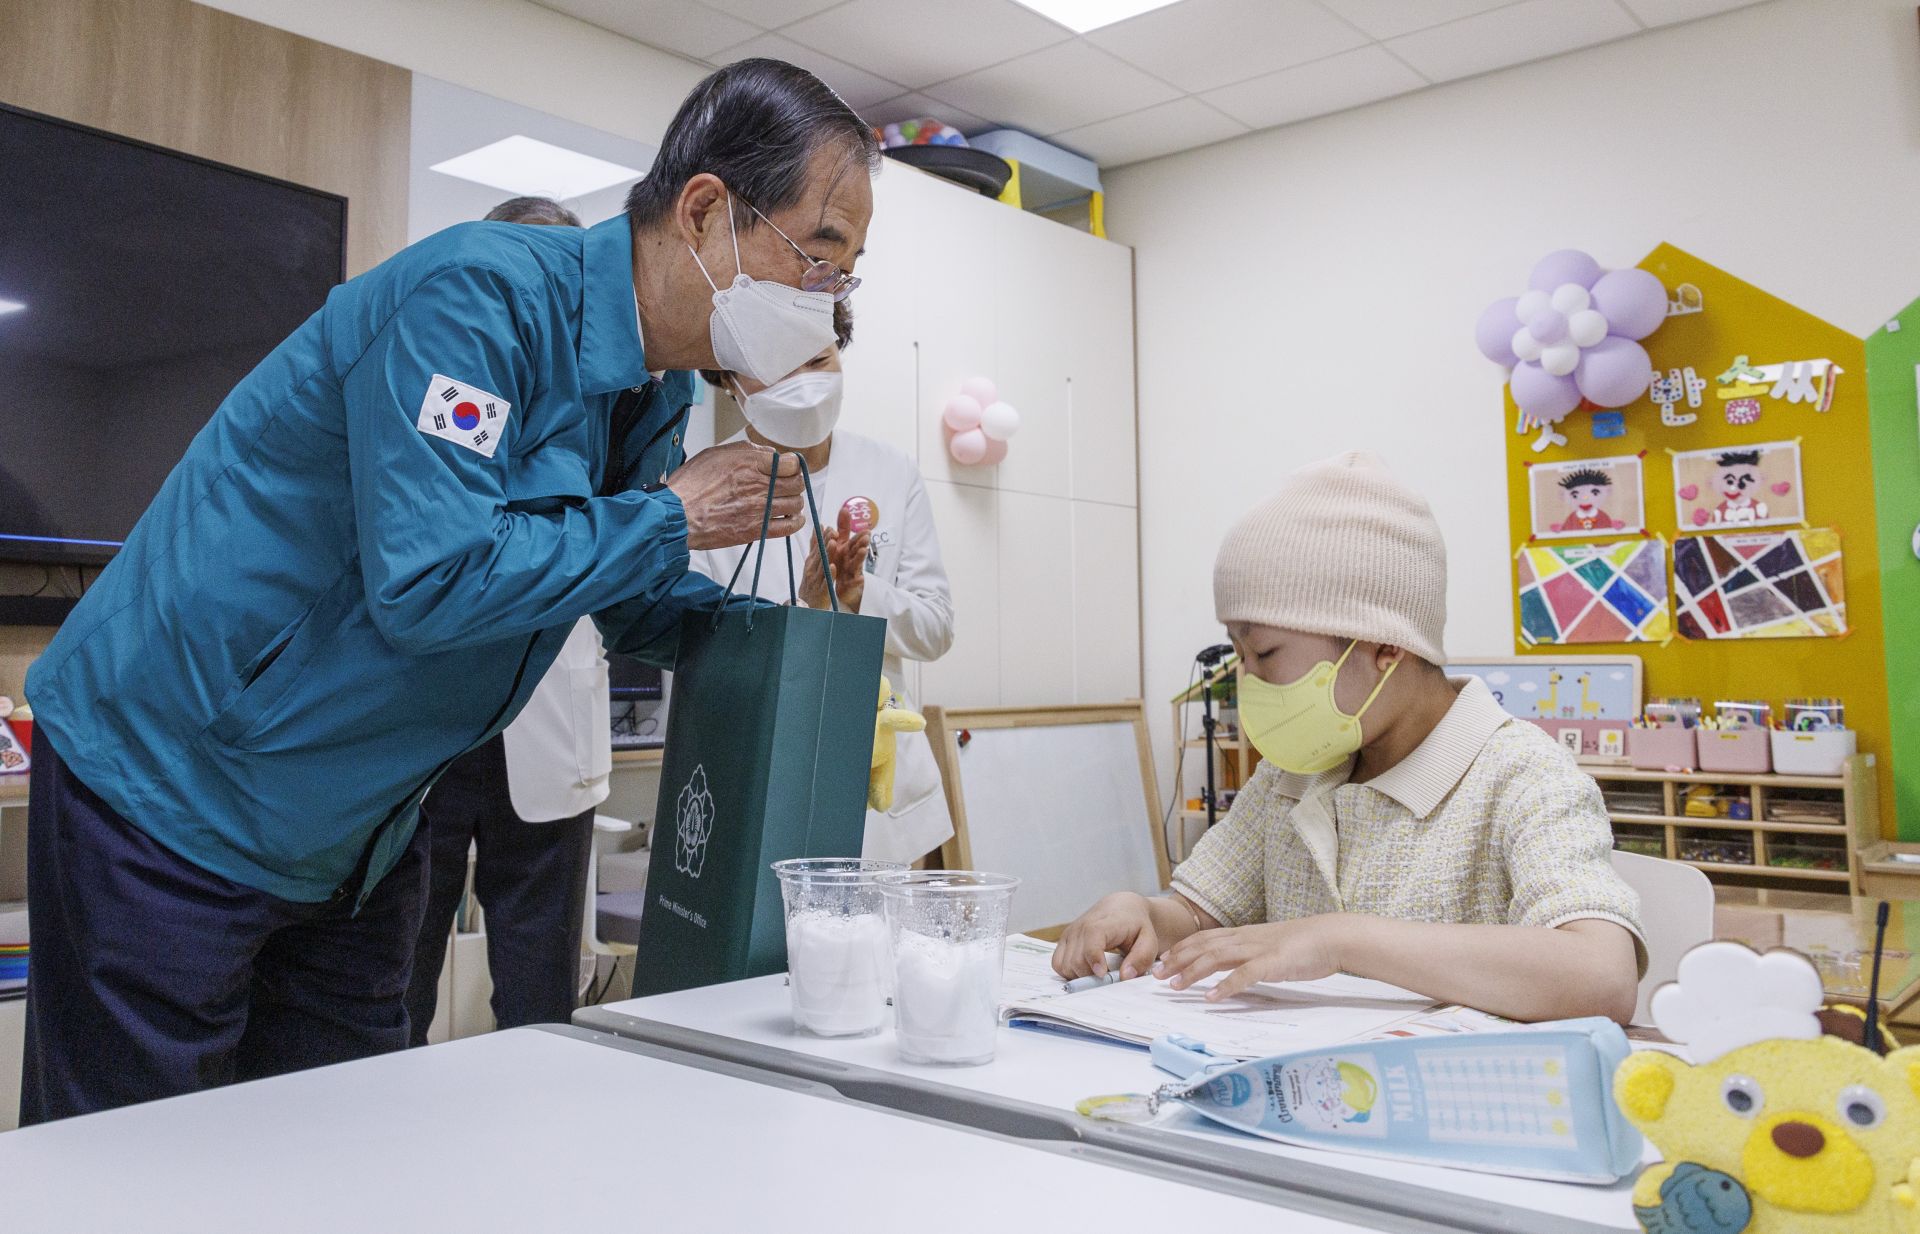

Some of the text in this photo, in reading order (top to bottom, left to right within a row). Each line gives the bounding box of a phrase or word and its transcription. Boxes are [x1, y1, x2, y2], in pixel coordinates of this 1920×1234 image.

[658, 894, 707, 929] Prime Minister's Office
